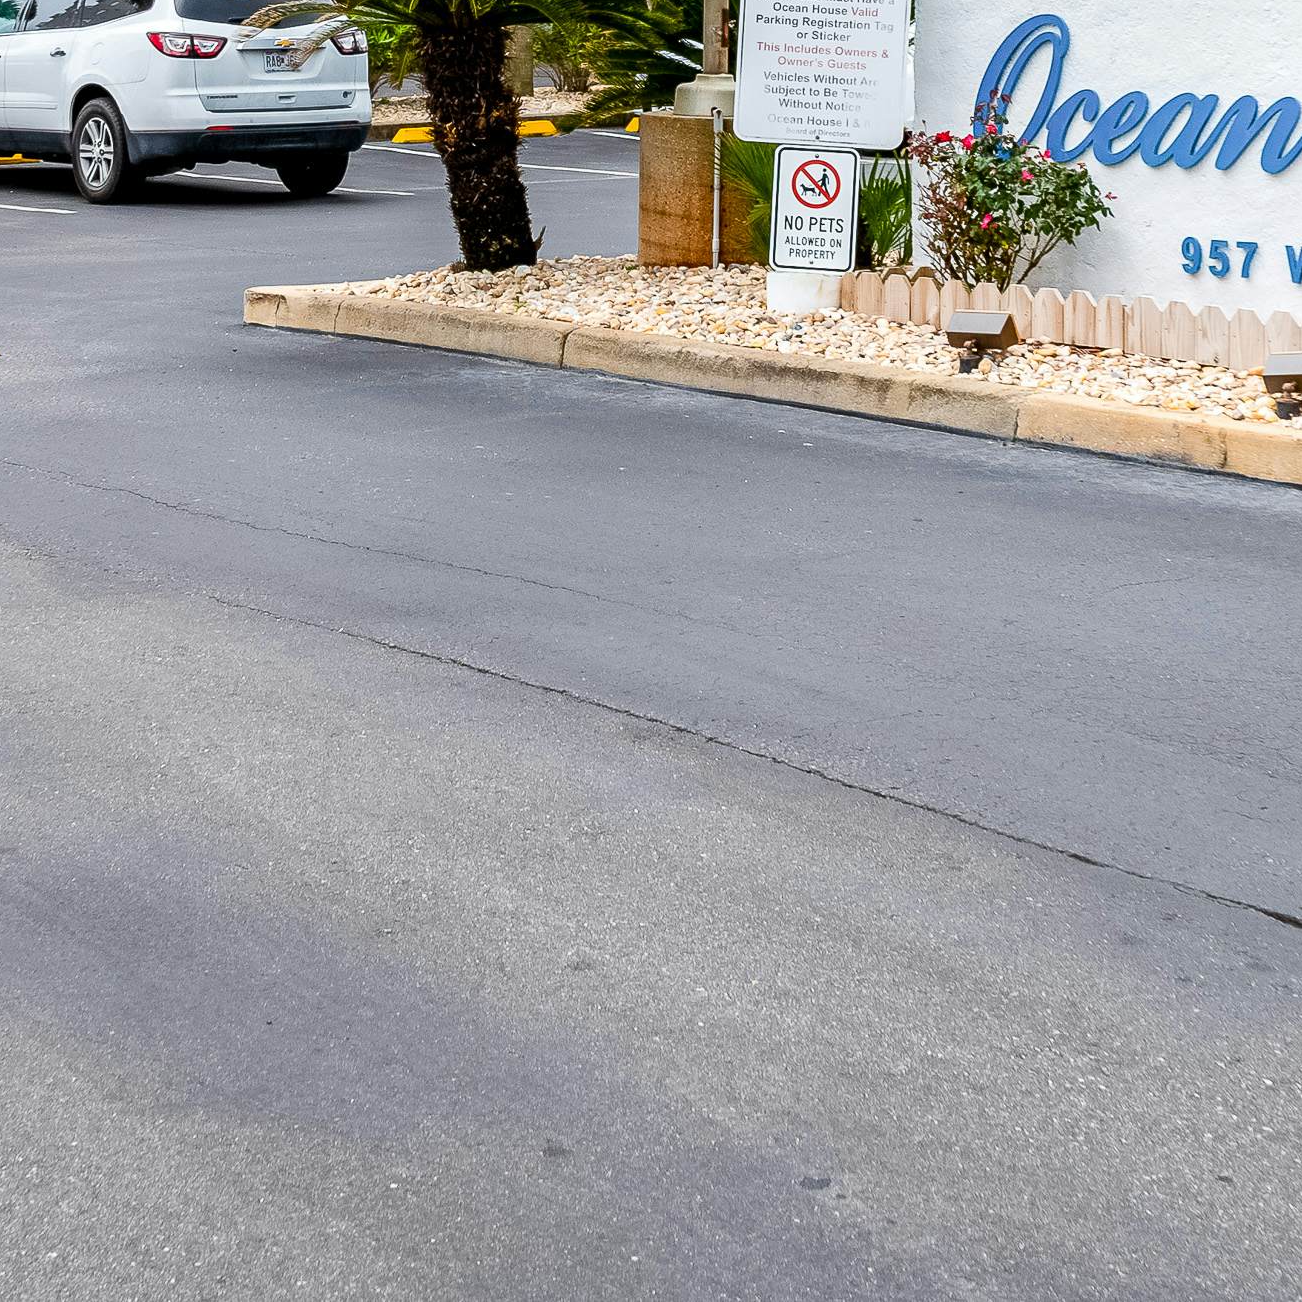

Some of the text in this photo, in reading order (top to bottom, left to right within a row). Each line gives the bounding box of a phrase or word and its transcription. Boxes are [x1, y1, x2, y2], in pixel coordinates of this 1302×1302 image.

[773, 2, 878, 17] Ocean House Valid
[756, 14, 894, 32] Parking Registration Tag
[796, 31, 851, 42] or Sticker
[756, 42, 889, 58] This Includes Owners &
[777, 56, 866, 70] Owner's Guests
[763, 71, 810, 82] Vehicles
[813, 74, 856, 86] Without
[764, 84, 806, 96] Subject
[809, 88, 820, 96] to
[823, 88, 838, 98] Be
[778, 98, 822, 110] Without
[767, 113, 802, 124] Ocean
[806, 116, 842, 127] House
[817, 129, 850, 138] Directors
[784, 215, 844, 233] NO PETS
[784, 236, 842, 248] ALLOWED ON
[789, 248, 836, 260] PROPERTY
[1181, 236, 1260, 279] 957
